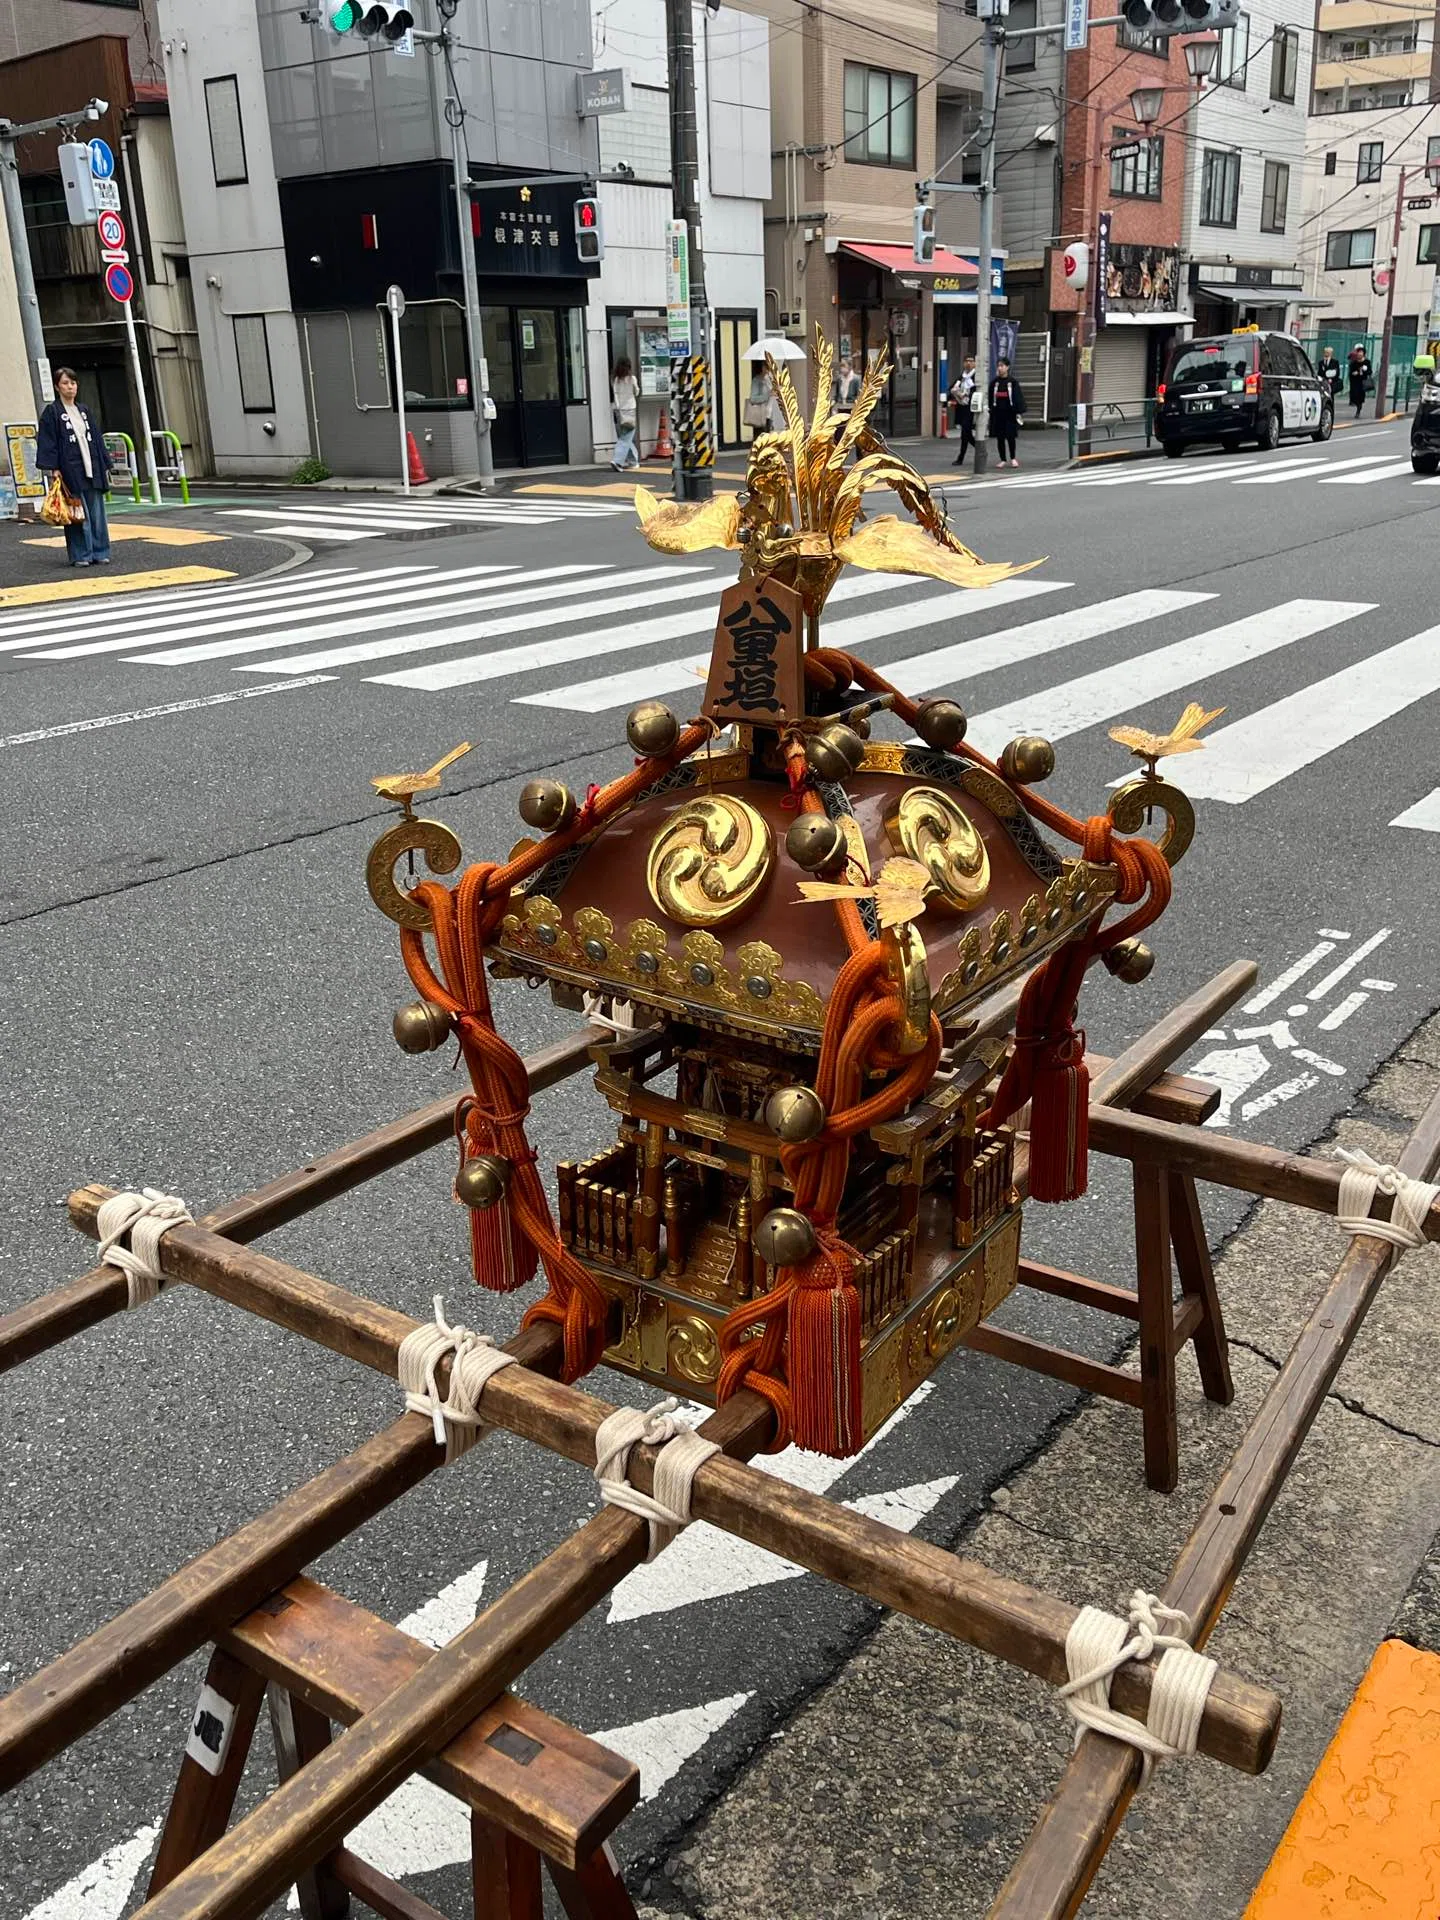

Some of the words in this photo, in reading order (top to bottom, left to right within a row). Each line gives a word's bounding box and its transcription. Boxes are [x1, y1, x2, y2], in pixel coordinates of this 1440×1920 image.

[587, 95, 620, 108] KOBAN
[104, 222, 119, 239] 20
[495, 227, 559, 247] 根津交番
[720, 597, 792, 712] 八重垣
